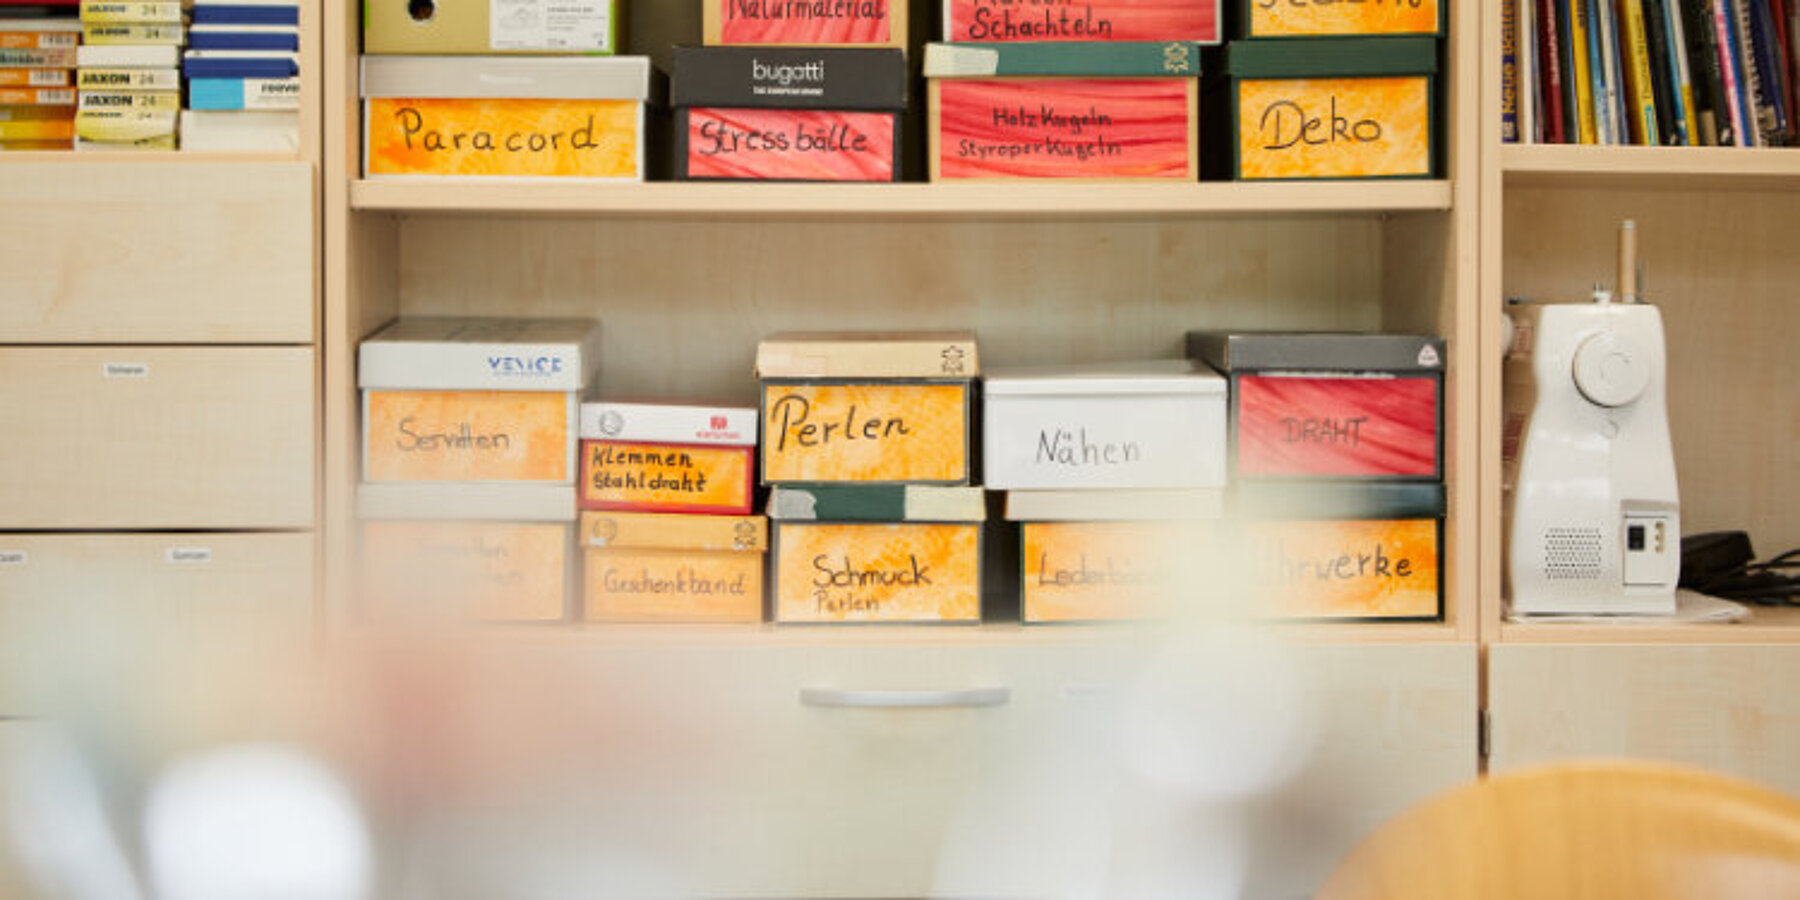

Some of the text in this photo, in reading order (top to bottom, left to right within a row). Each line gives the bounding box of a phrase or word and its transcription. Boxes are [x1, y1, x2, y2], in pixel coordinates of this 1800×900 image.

[969, 6, 1113, 39] Schachteln
[82, 73, 130, 84] JAXON
[753, 58, 824, 85] bugatti
[85, 95, 133, 106] JAXON
[394, 107, 600, 152] Paracord
[1259, 95, 1382, 150] Deko
[770, 394, 910, 452] Perlen
[1279, 416, 1368, 446] DRAHT
[1035, 425, 1140, 467] Nähen
[812, 553, 933, 588] Schmuck
[1262, 540, 1413, 581] hrwerke
[603, 567, 747, 596] Geschenkband
